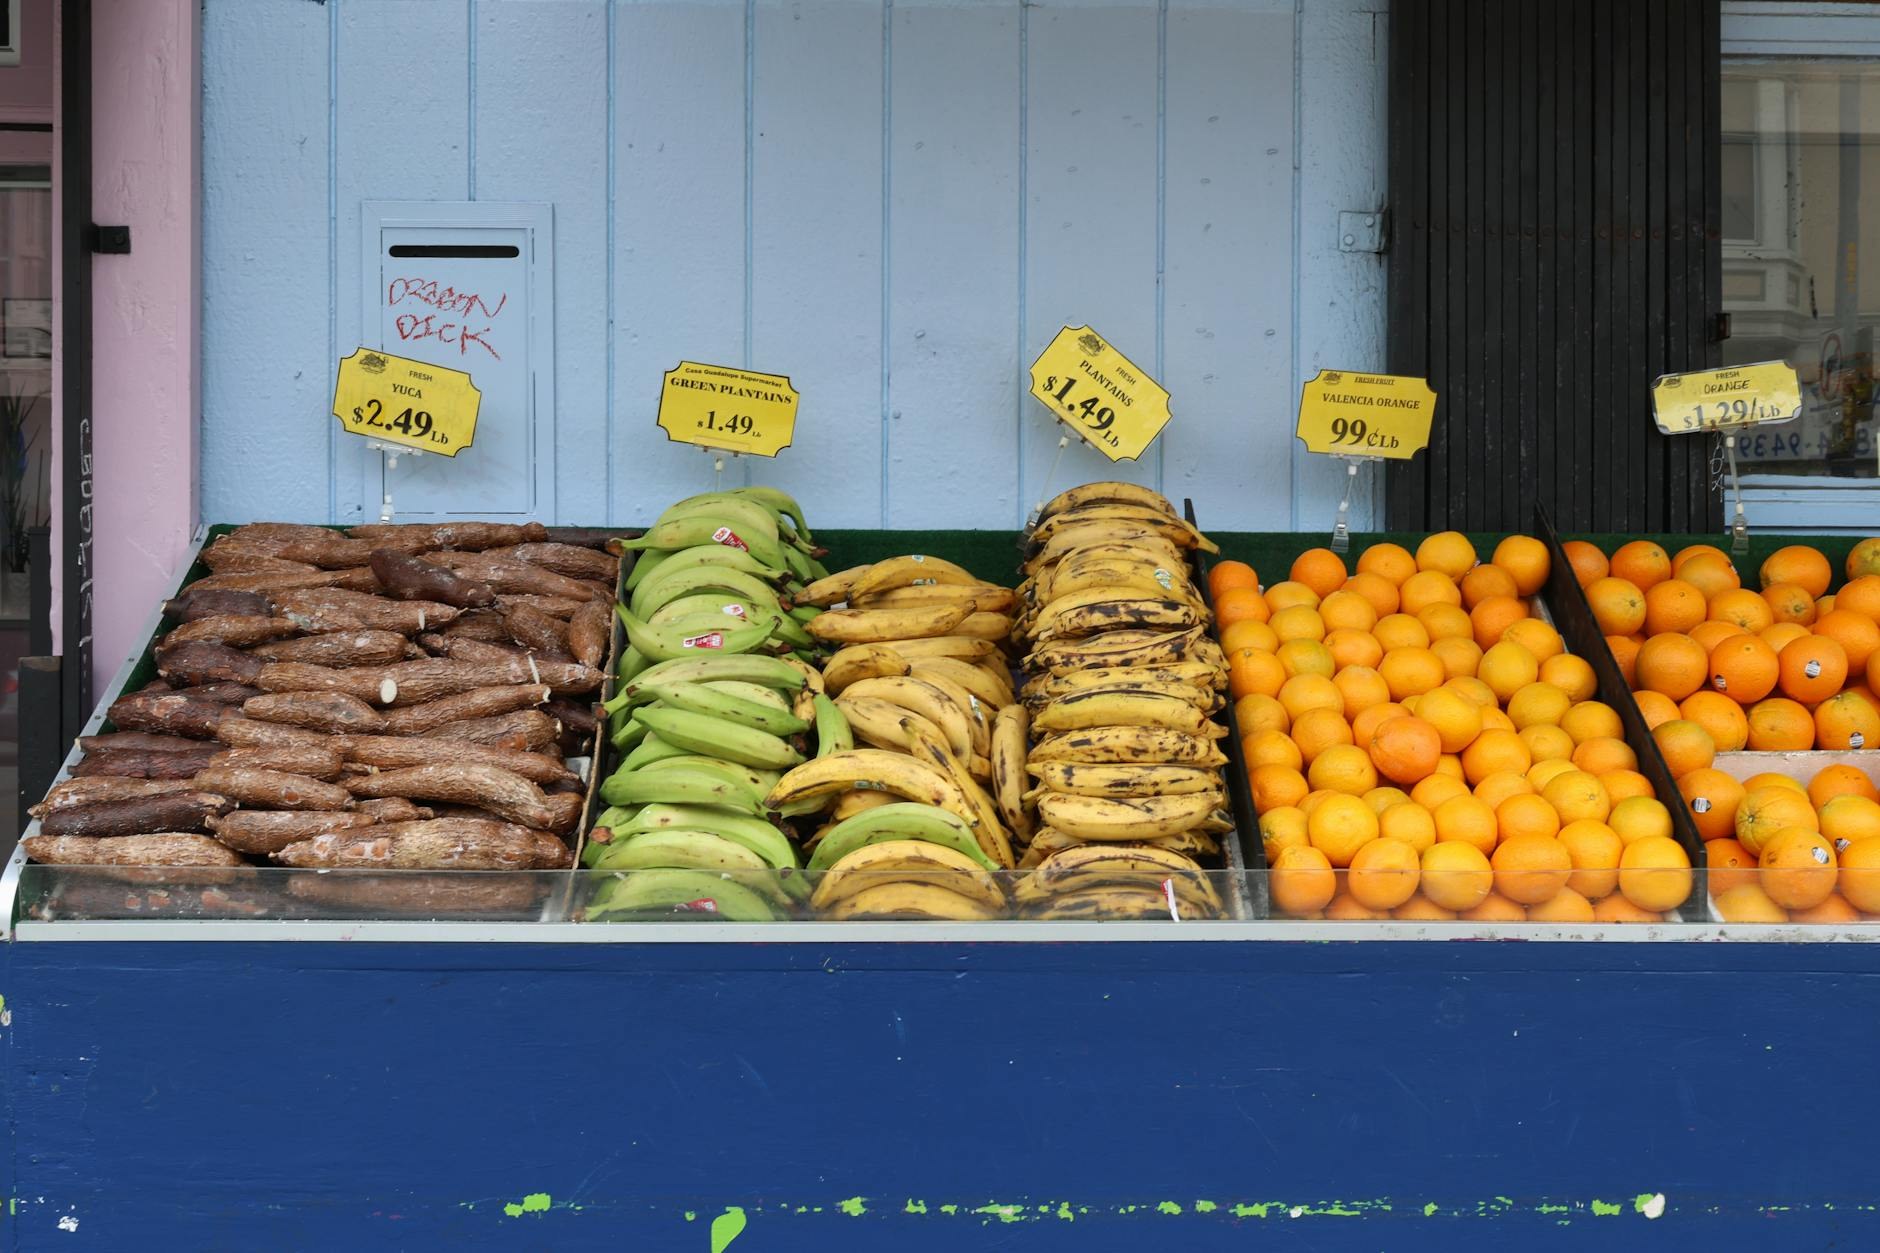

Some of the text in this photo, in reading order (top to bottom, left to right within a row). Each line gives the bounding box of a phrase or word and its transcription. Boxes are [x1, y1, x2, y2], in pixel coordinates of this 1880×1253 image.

[396, 314, 502, 360] DICK
[409, 370, 433, 382] FRESH
[685, 367, 782, 388] Casa Guadalupe Supermarket
[1080, 360, 1134, 408] PLANTAINS
[1115, 366, 1137, 386] FRESH
[1715, 371, 1740, 380] FRESH
[392, 383, 422, 399] YUCA
[670, 376, 793, 405] GREEN PLANTAINS
[1704, 379, 1751, 395] ORANGE
[1323, 393, 1421, 410] VALENCIA ORANGE
